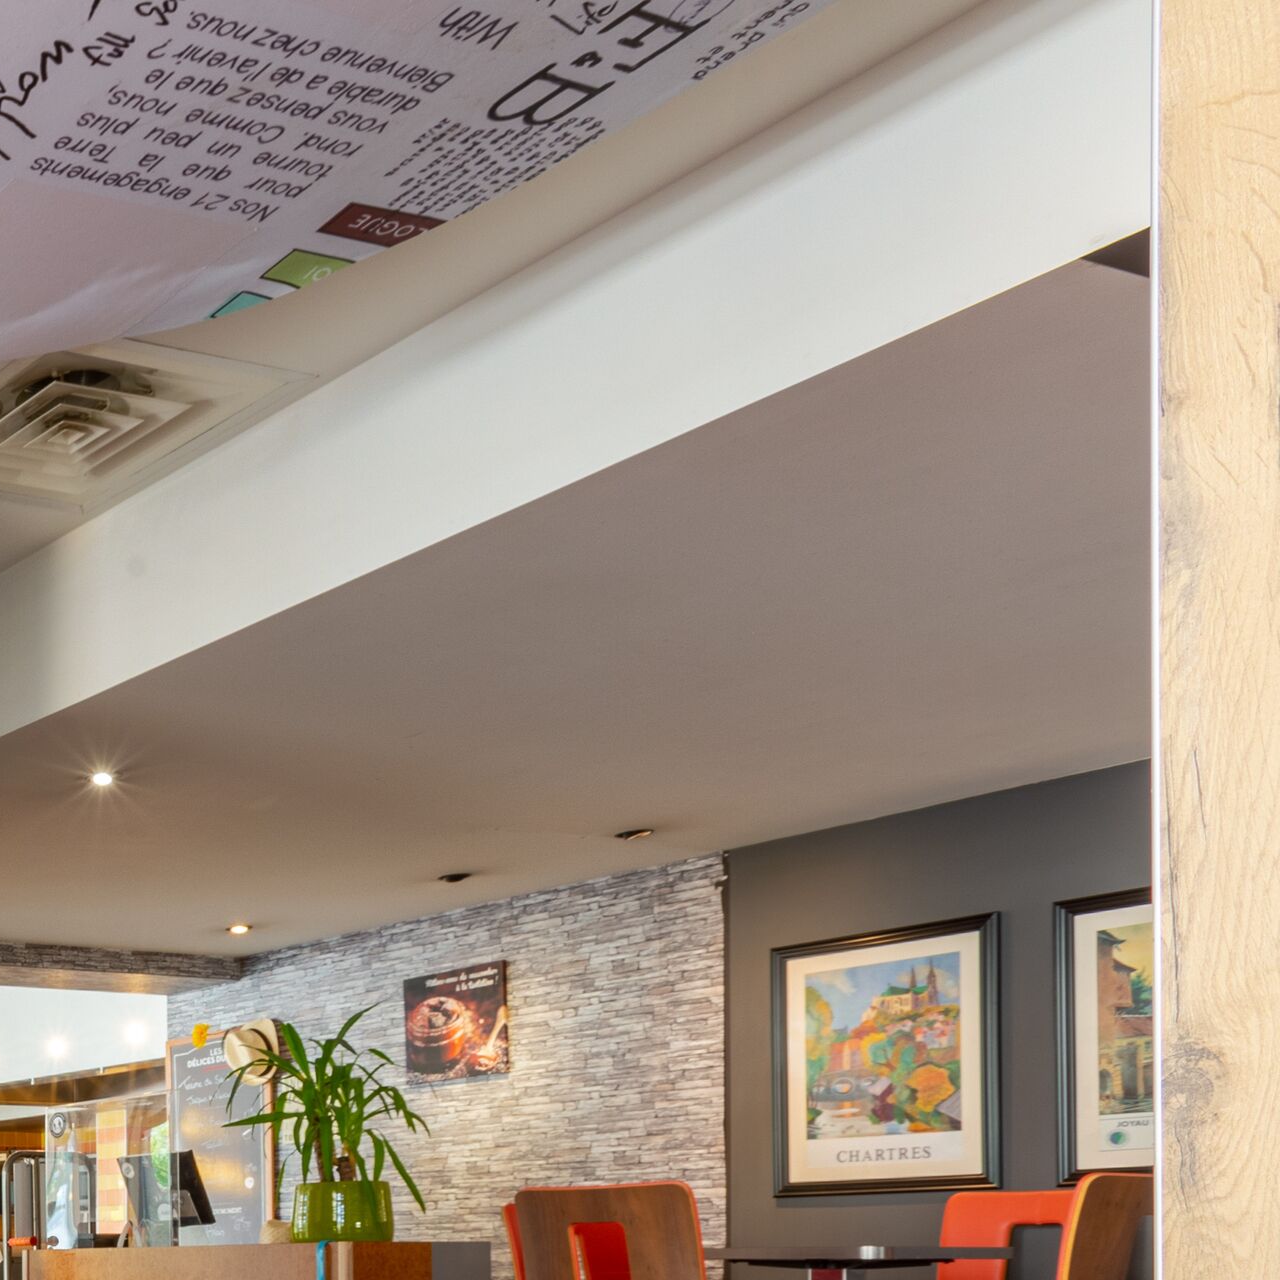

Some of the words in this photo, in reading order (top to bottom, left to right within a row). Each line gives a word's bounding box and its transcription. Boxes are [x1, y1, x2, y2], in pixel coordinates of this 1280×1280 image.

[186, 11, 254, 41] nous.
[253, 28, 321, 58] chez
[171, 43, 268, 81] l'avenir
[321, 46, 456, 94] Bienvenue
[144, 67, 171, 87] le
[174, 74, 228, 99] que
[269, 65, 303, 86] de
[305, 74, 328, 90] a
[107, 83, 177, 117] nous,
[226, 89, 326, 122] pensez
[326, 79, 421, 114] durable
[76, 111, 138, 140] plus
[185, 107, 286, 145] Comme
[329, 111, 391, 136] vous
[54, 134, 118, 166] Terre
[143, 125, 199, 149] peu
[207, 139, 242, 159] un
[295, 131, 365, 159] rond.
[138, 151, 161, 170] la
[182, 162, 231, 183] que
[252, 150, 335, 180] tourne
[30, 156, 190, 203] engagements
[243, 176, 312, 200] pour
[191, 192, 228, 213] 21
[228, 198, 279, 224] Nos
[1116, 1120, 1149, 1128] JOYAU
[836, 1145, 932, 1163] CHARTRES
